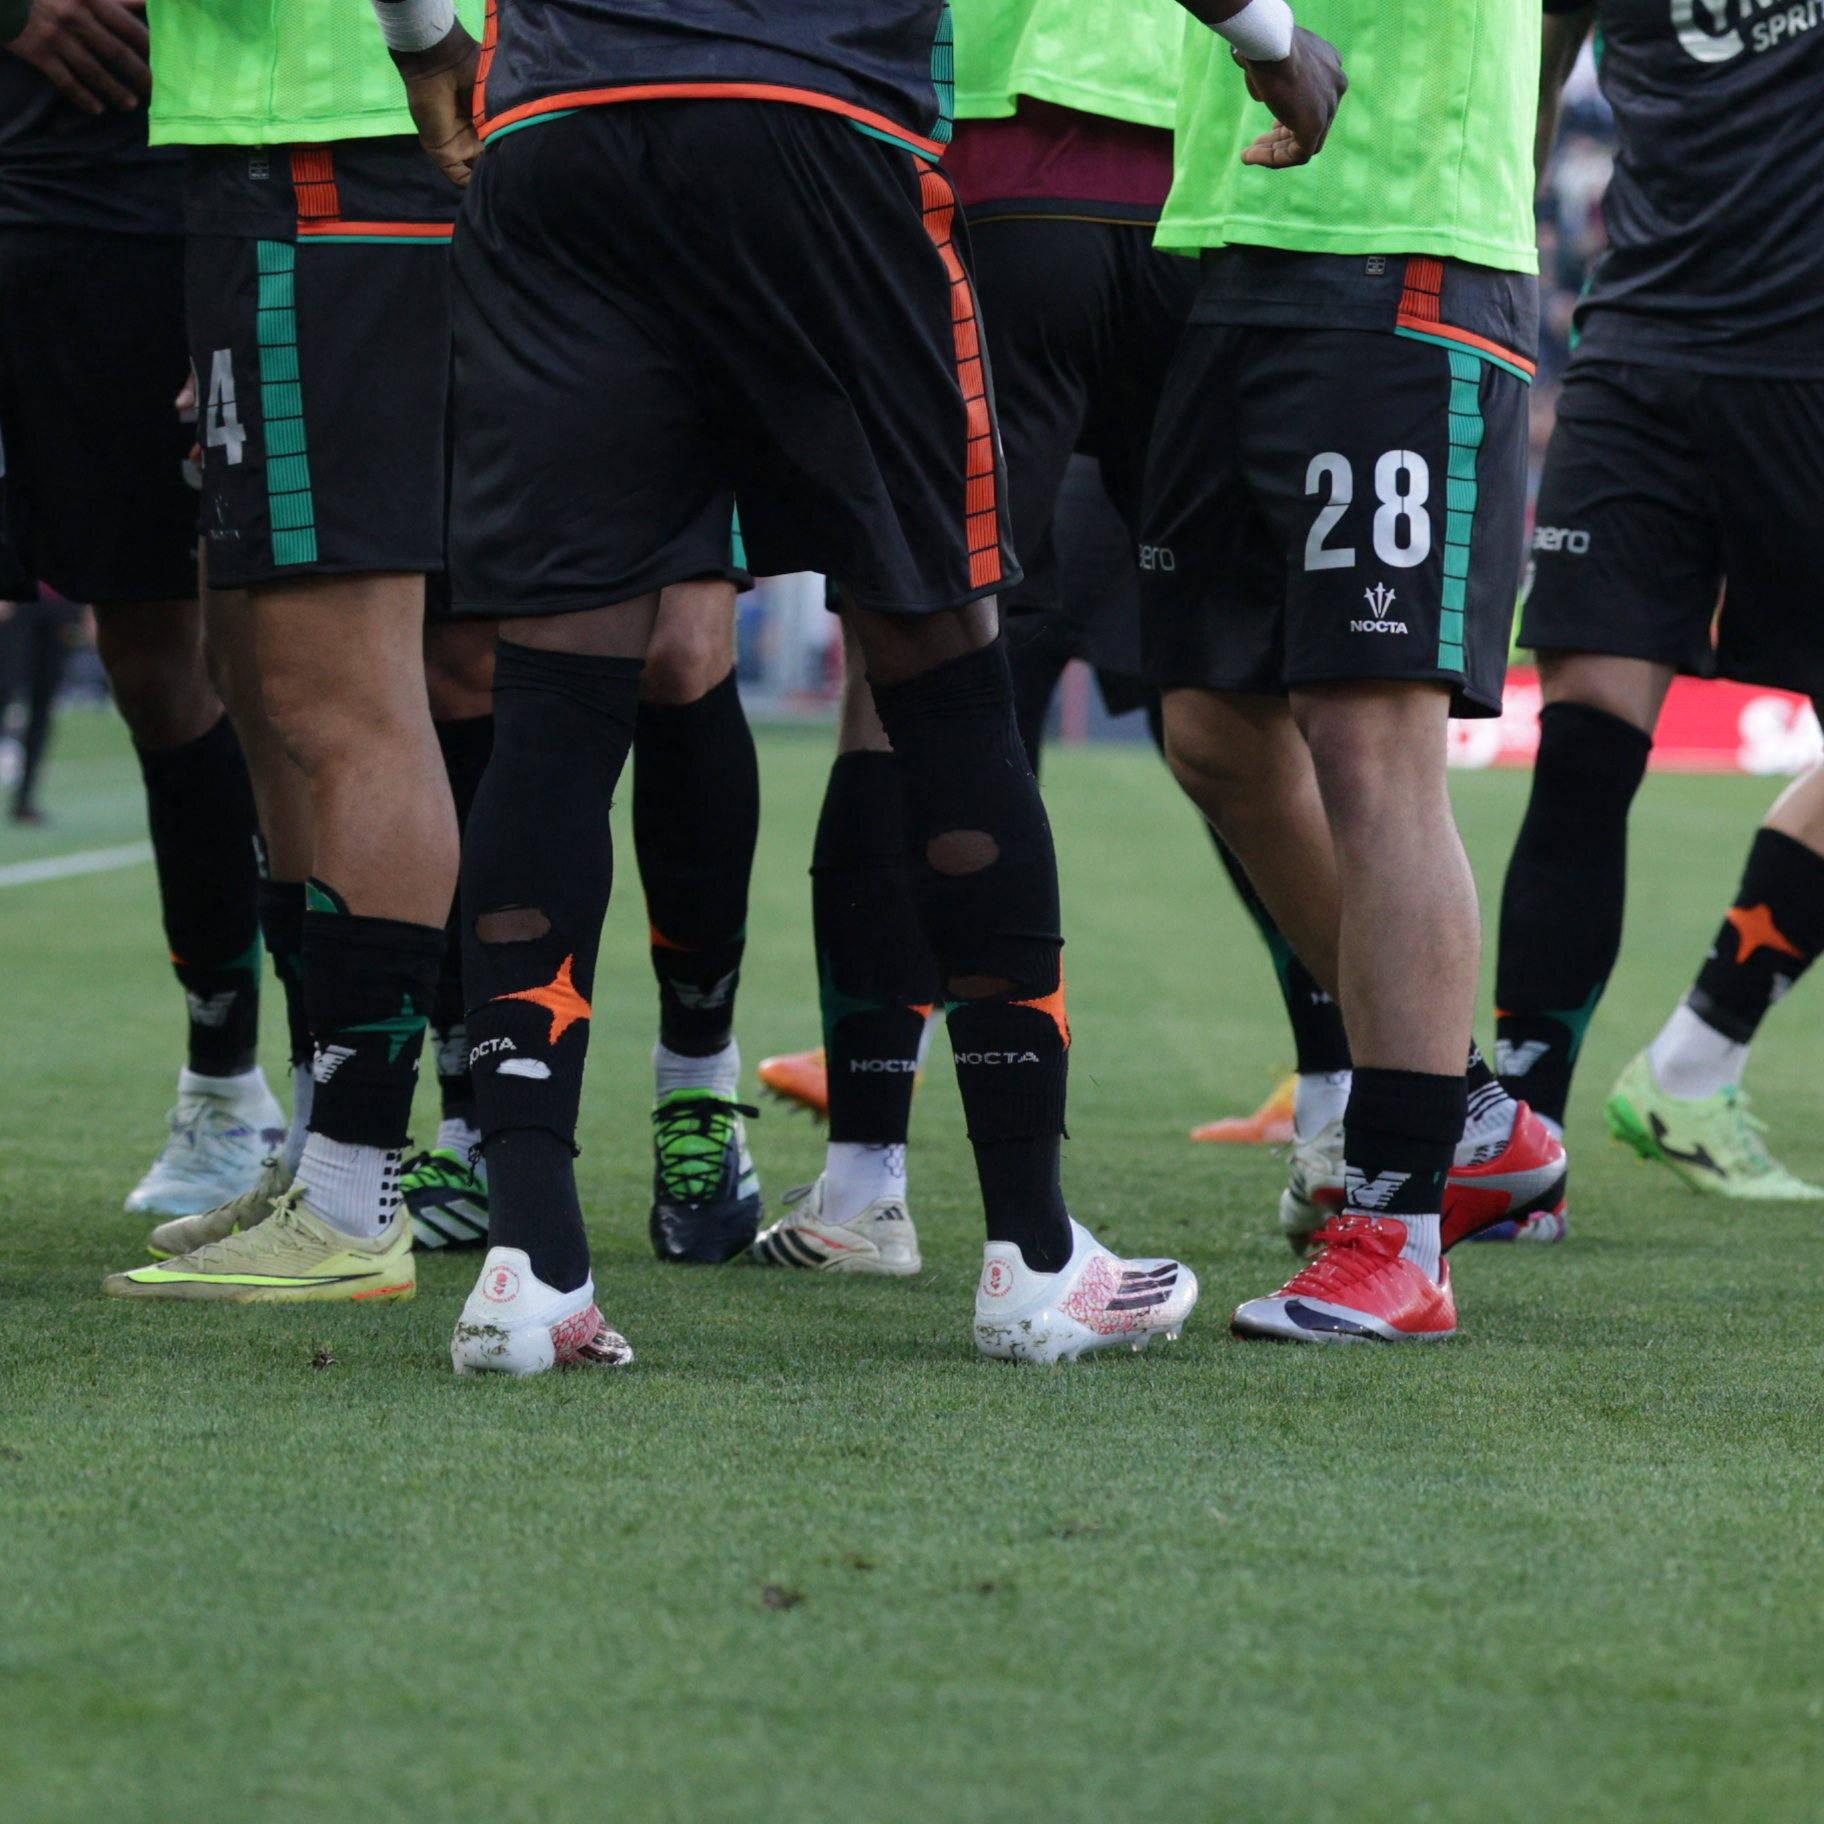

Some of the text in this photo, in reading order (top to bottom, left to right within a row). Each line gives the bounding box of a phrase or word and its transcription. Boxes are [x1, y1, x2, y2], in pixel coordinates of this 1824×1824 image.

[190, 348, 248, 466] 4
[1304, 449, 1431, 572] 28
[1351, 620, 1409, 635] NOCTA
[469, 1037, 517, 1069] OCTA
[954, 1051, 1040, 1065] NOCTA
